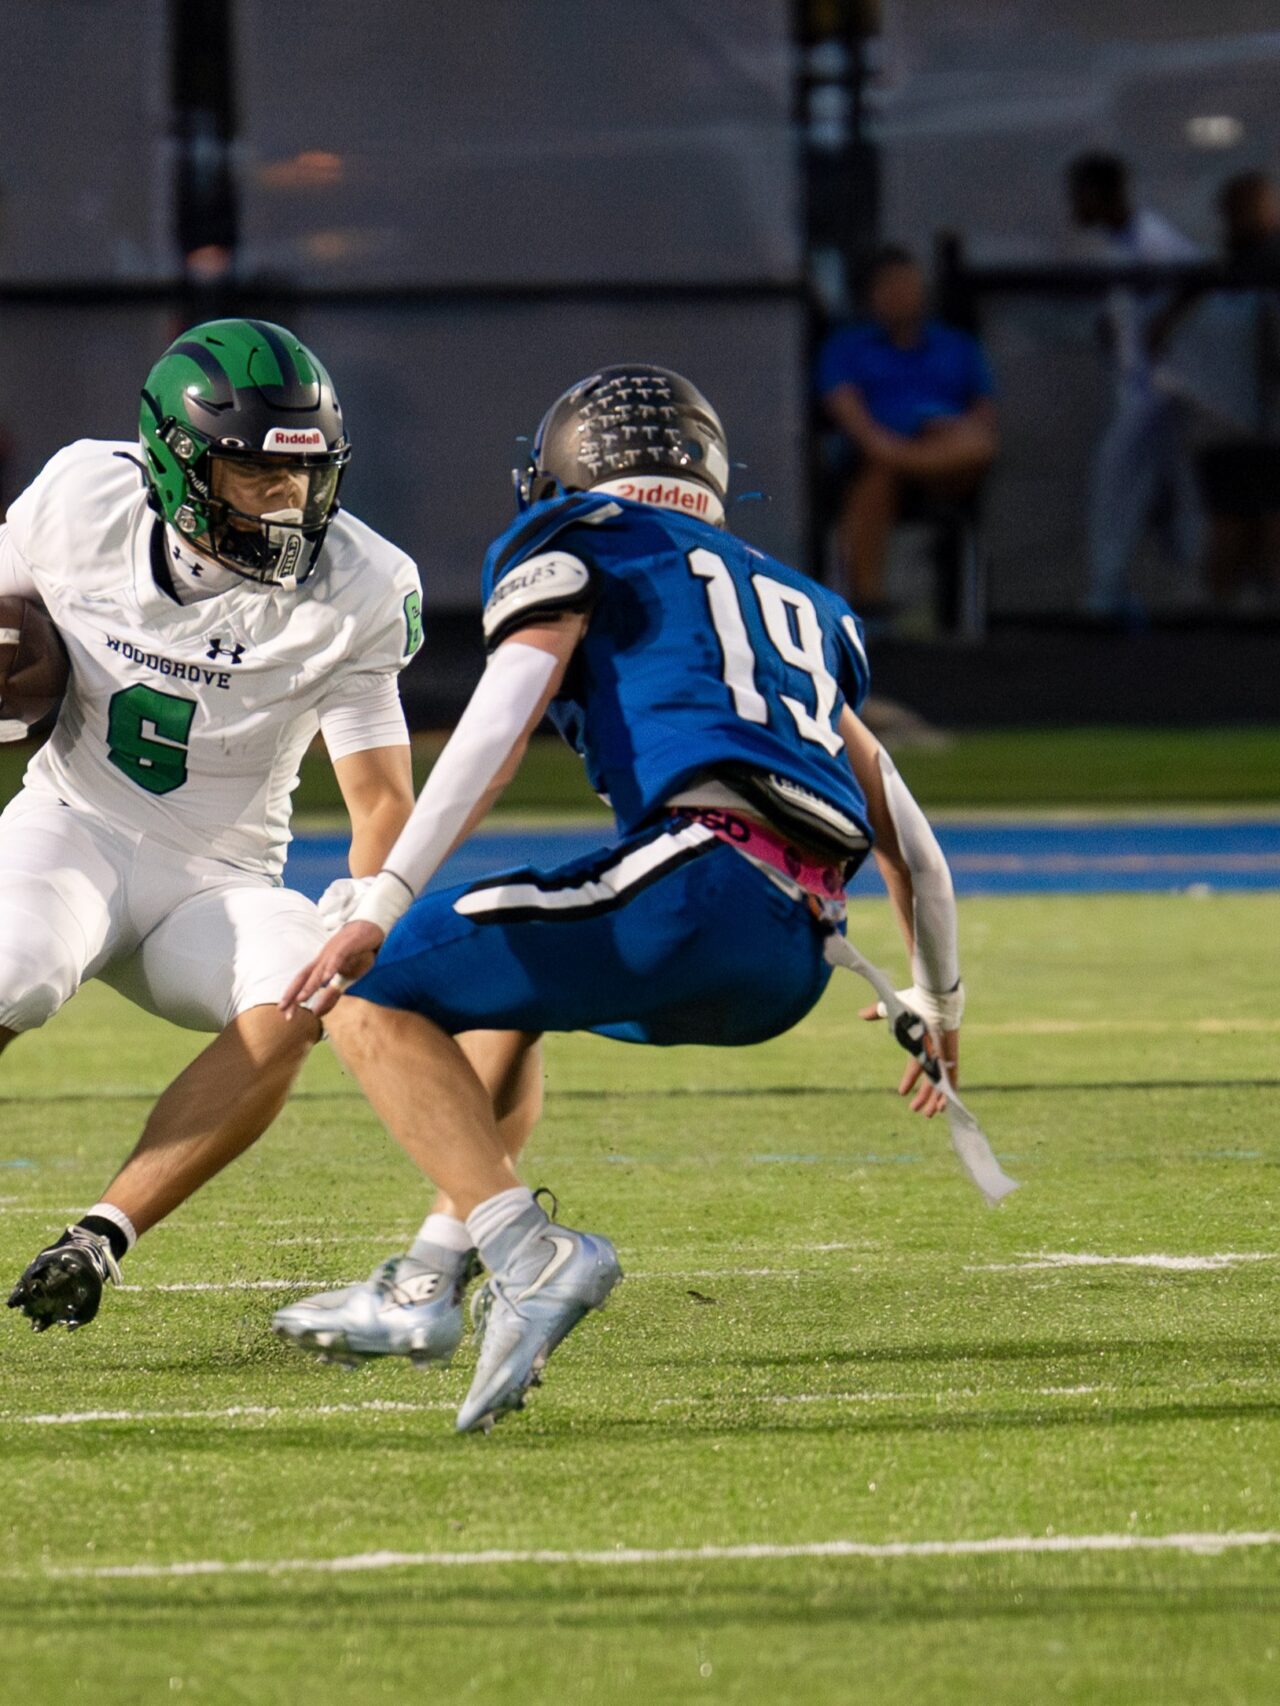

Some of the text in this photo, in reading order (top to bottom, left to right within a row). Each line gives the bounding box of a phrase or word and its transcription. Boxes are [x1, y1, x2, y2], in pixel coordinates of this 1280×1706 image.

[275, 432, 320, 445] Riddell
[105, 635, 232, 689] WOODGROVE
[687, 547, 845, 757] 19
[106, 682, 198, 796] 6
